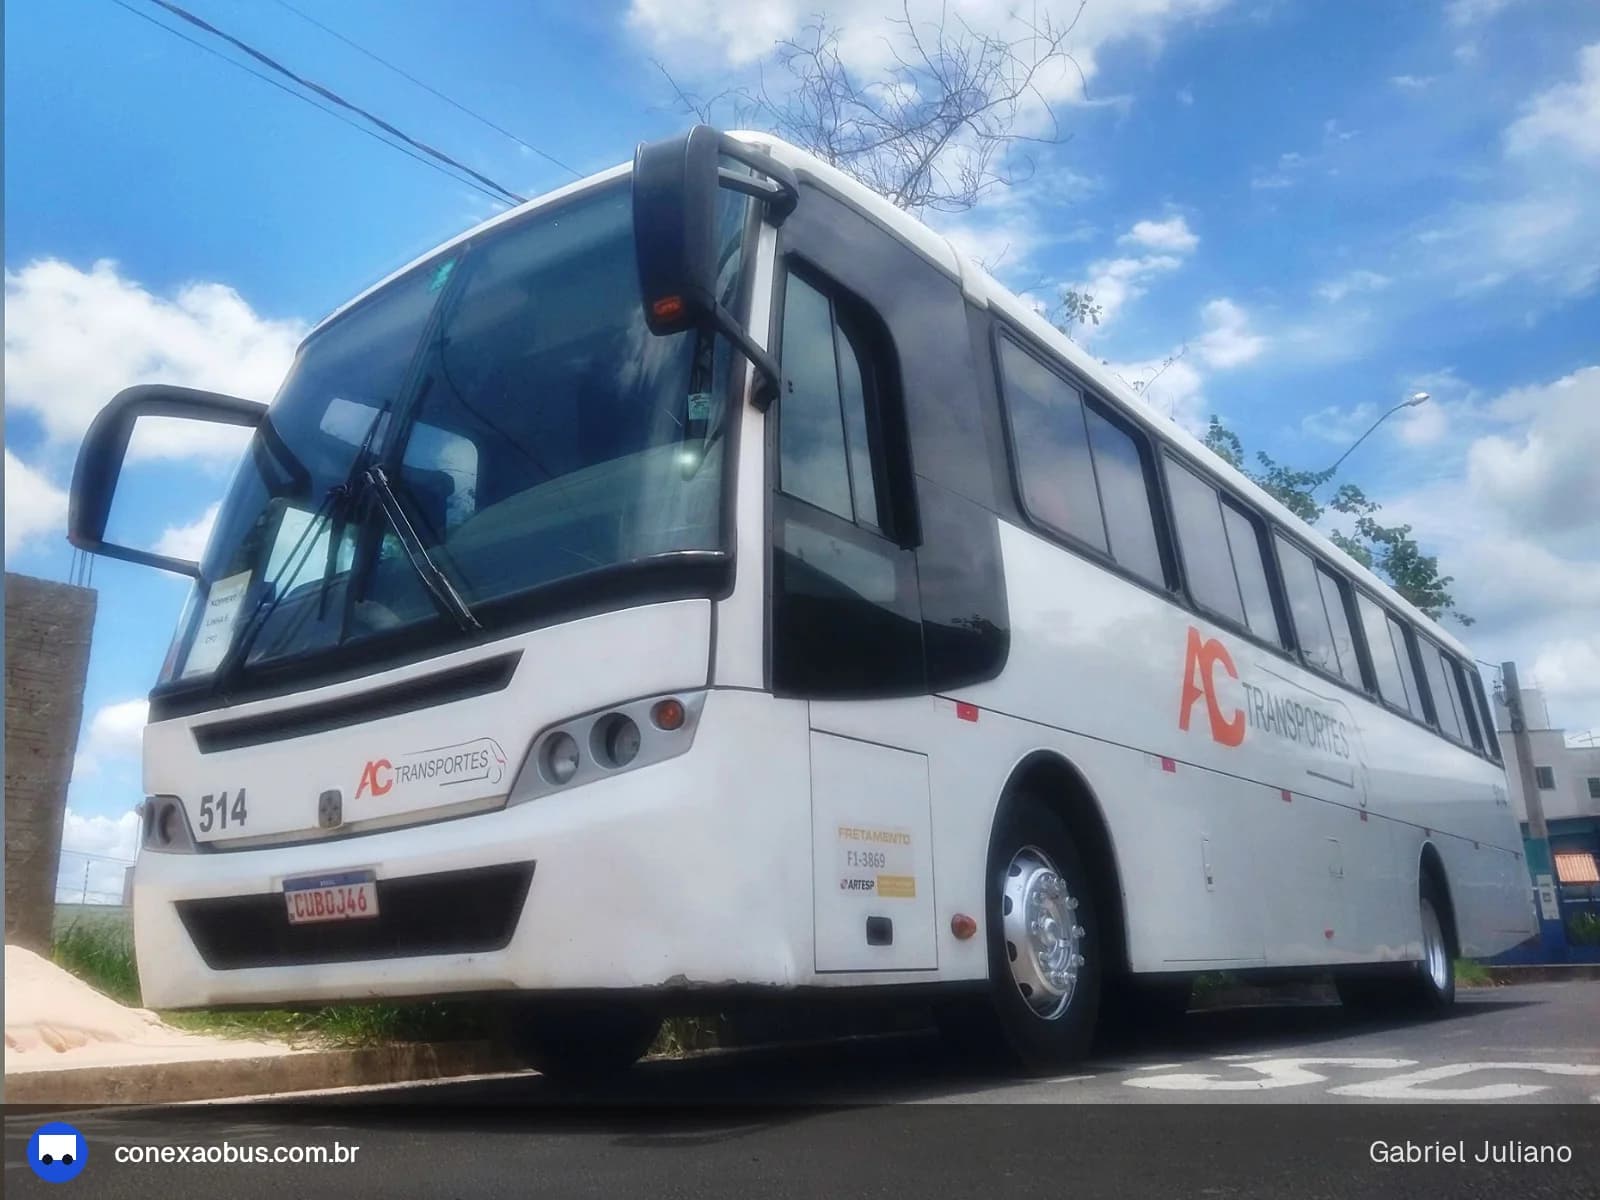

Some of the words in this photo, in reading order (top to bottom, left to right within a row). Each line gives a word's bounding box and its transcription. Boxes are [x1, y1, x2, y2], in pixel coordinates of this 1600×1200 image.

[1179, 625, 1245, 747] AC
[1242, 682, 1350, 759] TRANSPORTES
[355, 759, 393, 800] AC
[394, 750, 488, 784] TRANSPORTES
[199, 788, 248, 833] 514
[838, 827, 911, 845] FRETAMENTO
[848, 879, 875, 890] ARTESP
